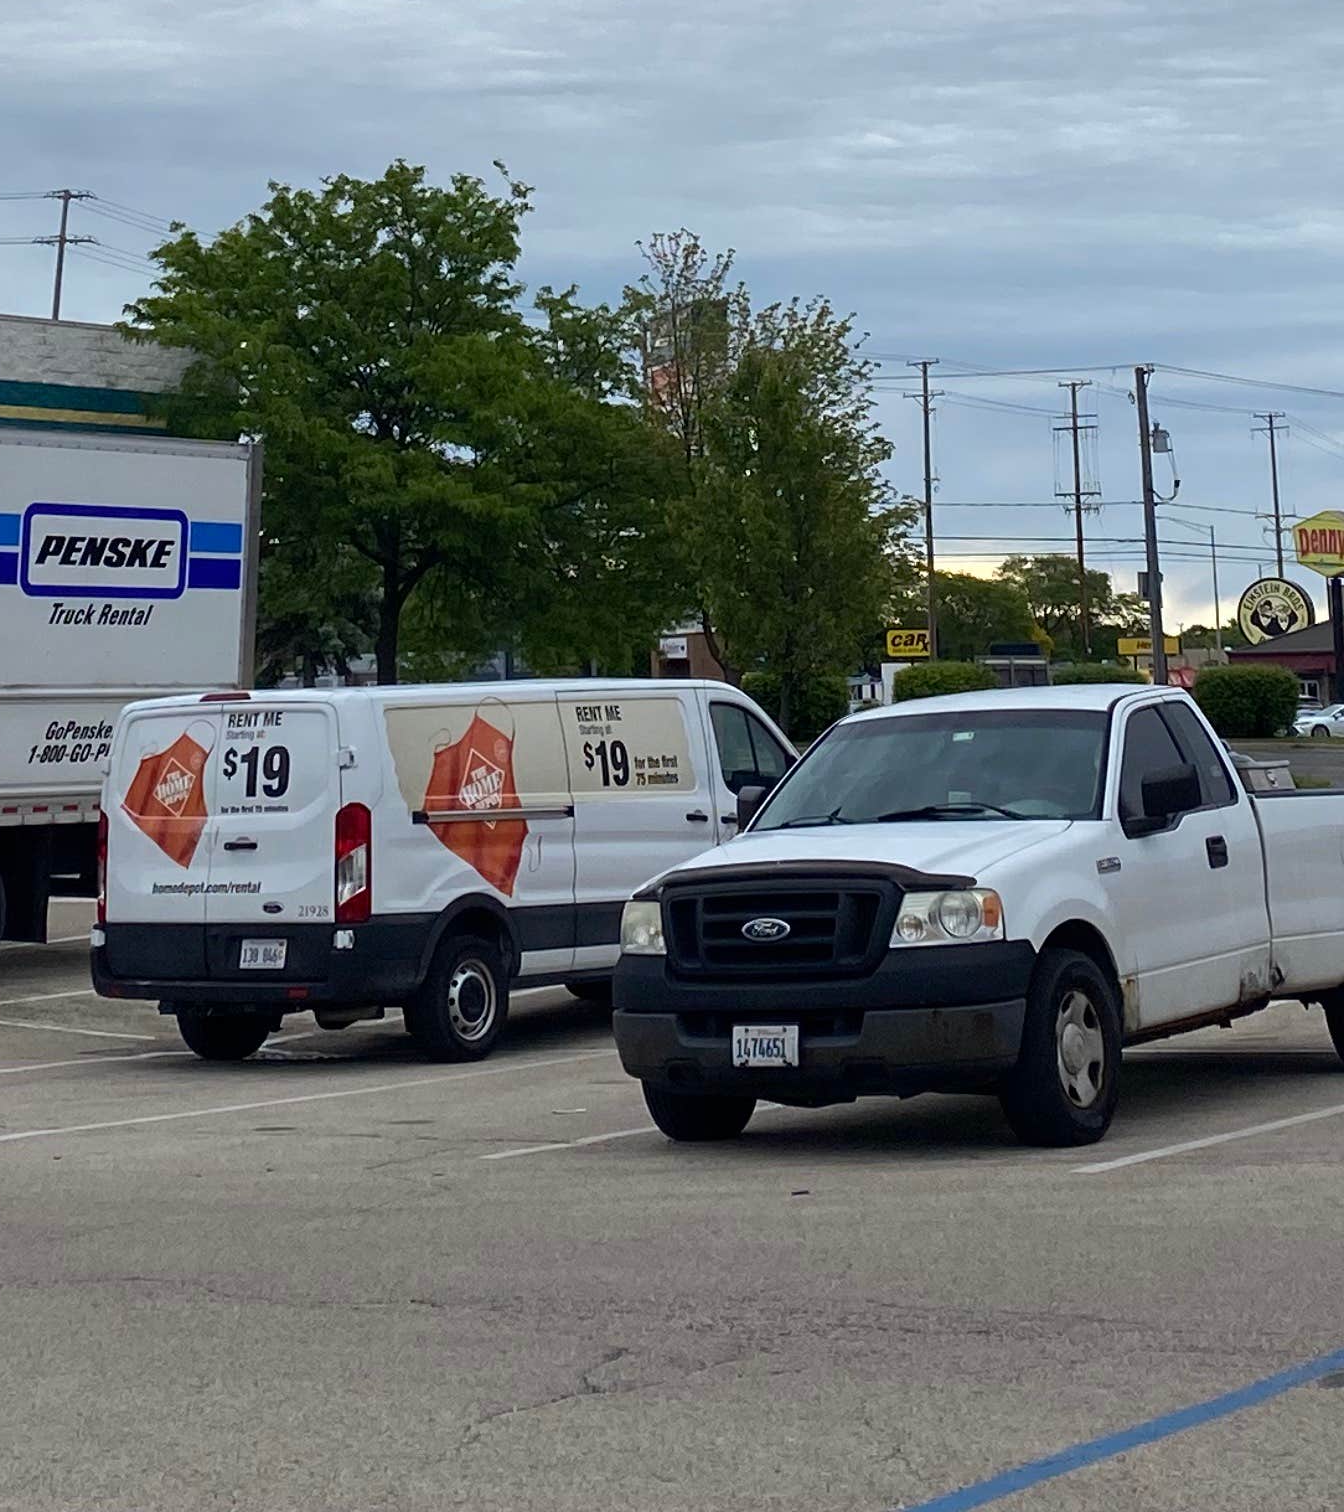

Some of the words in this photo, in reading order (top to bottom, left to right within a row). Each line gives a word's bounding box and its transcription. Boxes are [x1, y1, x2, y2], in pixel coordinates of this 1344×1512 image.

[35, 535, 175, 568] PENSKE
[1244, 582, 1280, 611] EINSTEIN
[1282, 586, 1304, 611] BROS
[48, 602, 96, 625] Truck
[97, 603, 154, 626] Rental
[228, 712, 258, 728] RENT
[263, 712, 283, 727] ME
[576, 706, 602, 722] RENT
[605, 705, 622, 721] ME
[226, 730, 254, 741] Starting
[583, 740, 630, 786] $19
[634, 756, 645, 769] for
[647, 755, 660, 768] the
[661, 754, 678, 768] first
[223, 745, 290, 798] $19
[648, 771, 678, 785] minutes
[152, 881, 262, 896] homedepot.com/rental
[298, 905, 329, 918] 21928
